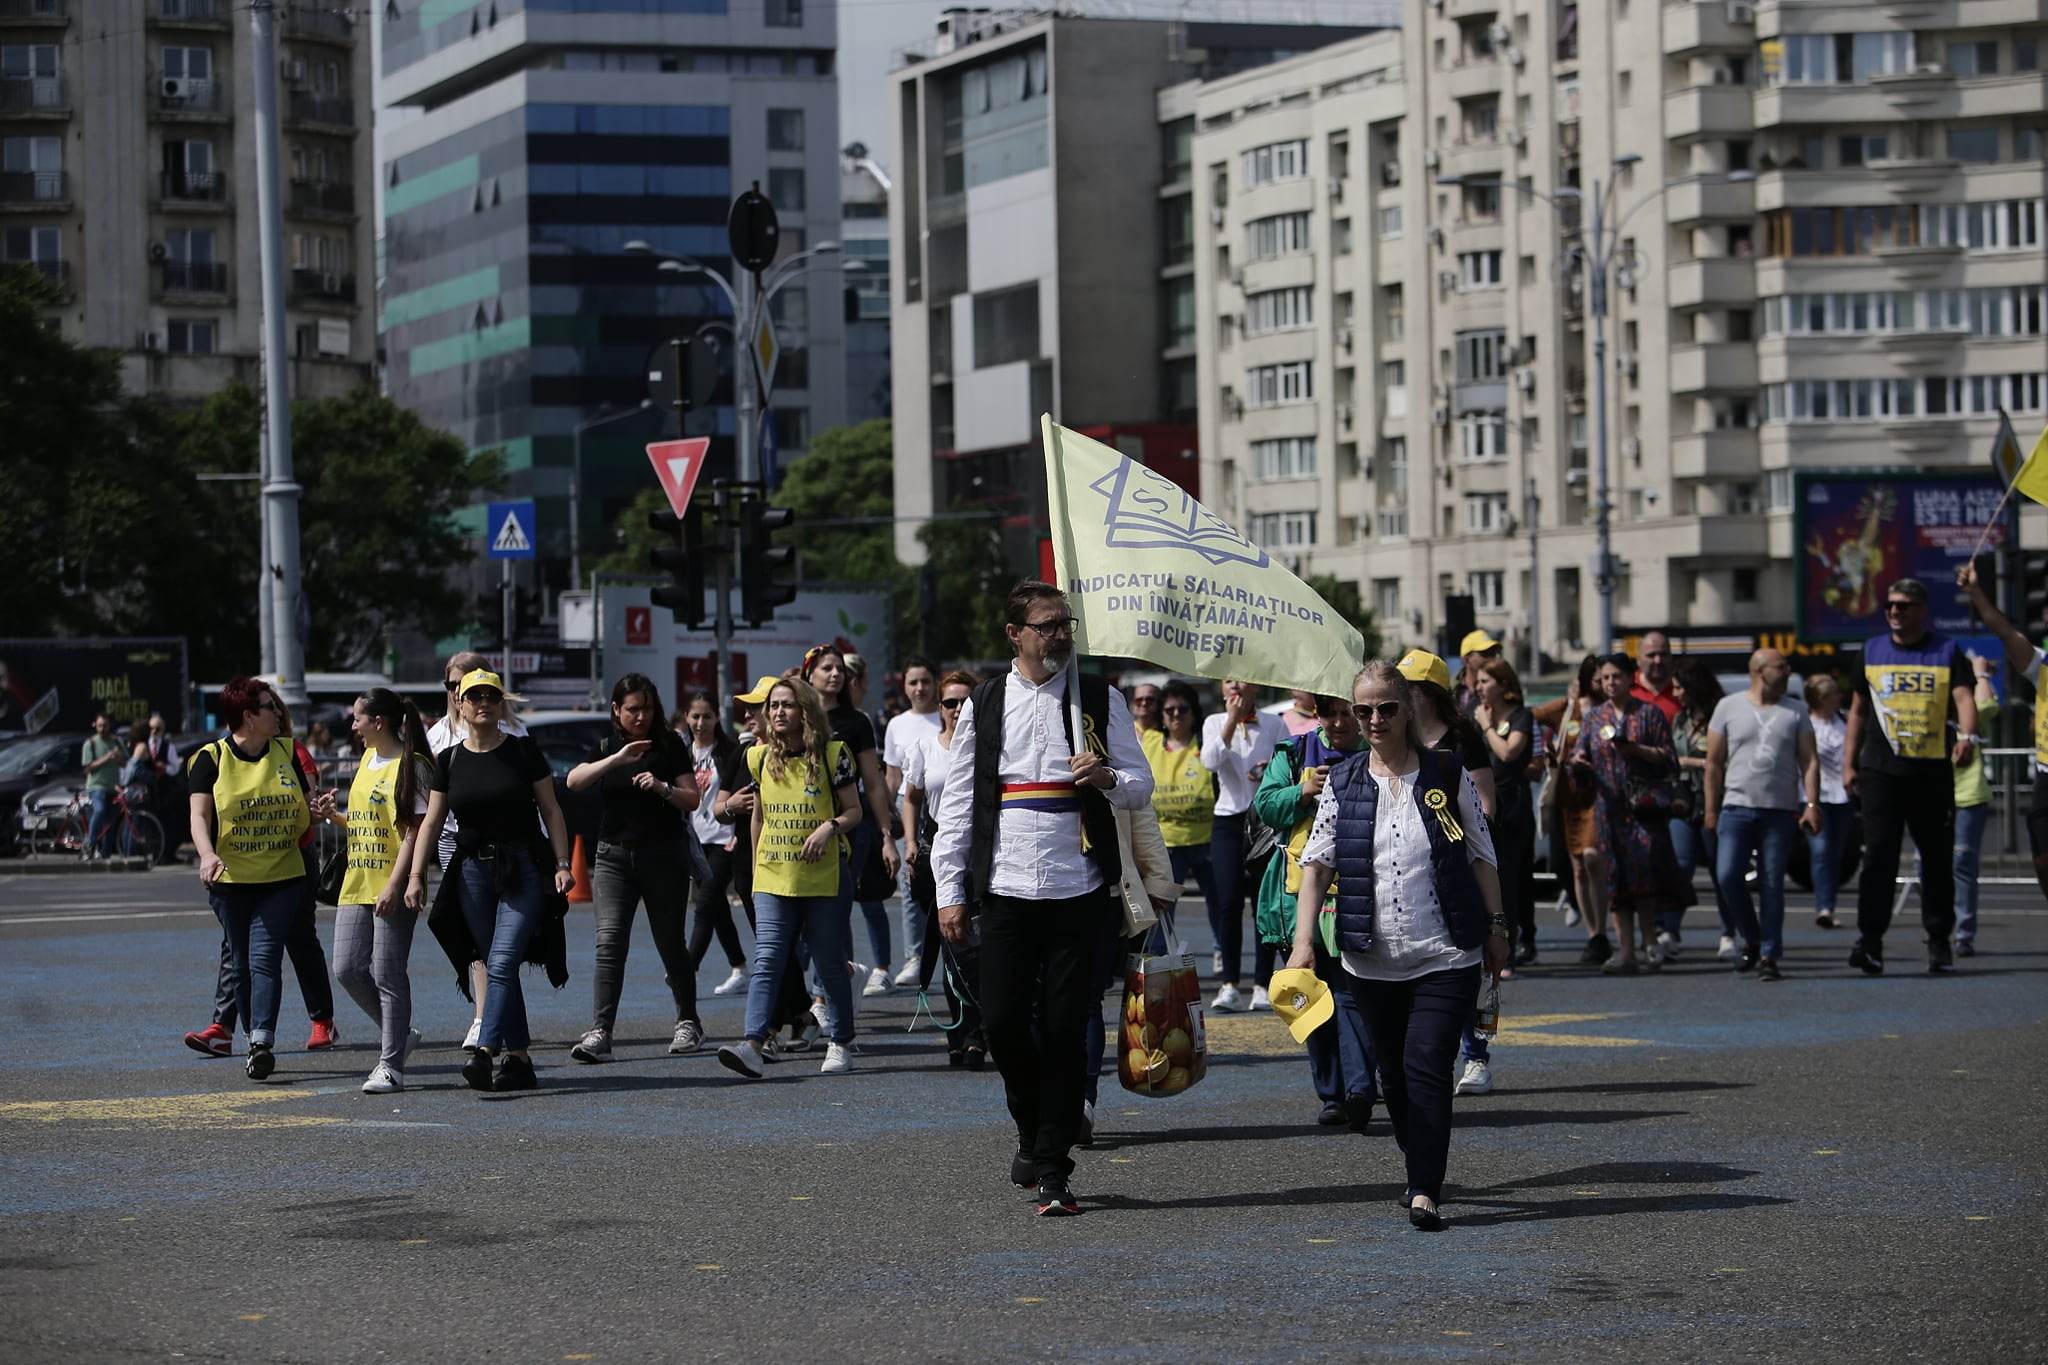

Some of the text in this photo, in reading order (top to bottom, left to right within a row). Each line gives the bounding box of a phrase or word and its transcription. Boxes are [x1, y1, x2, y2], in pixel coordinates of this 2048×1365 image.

[1070, 573, 1178, 594] INDICATUL
[1107, 595, 1143, 612] DIN
[232, 826, 251, 836] DIN
[770, 835, 805, 846] EDUCA
